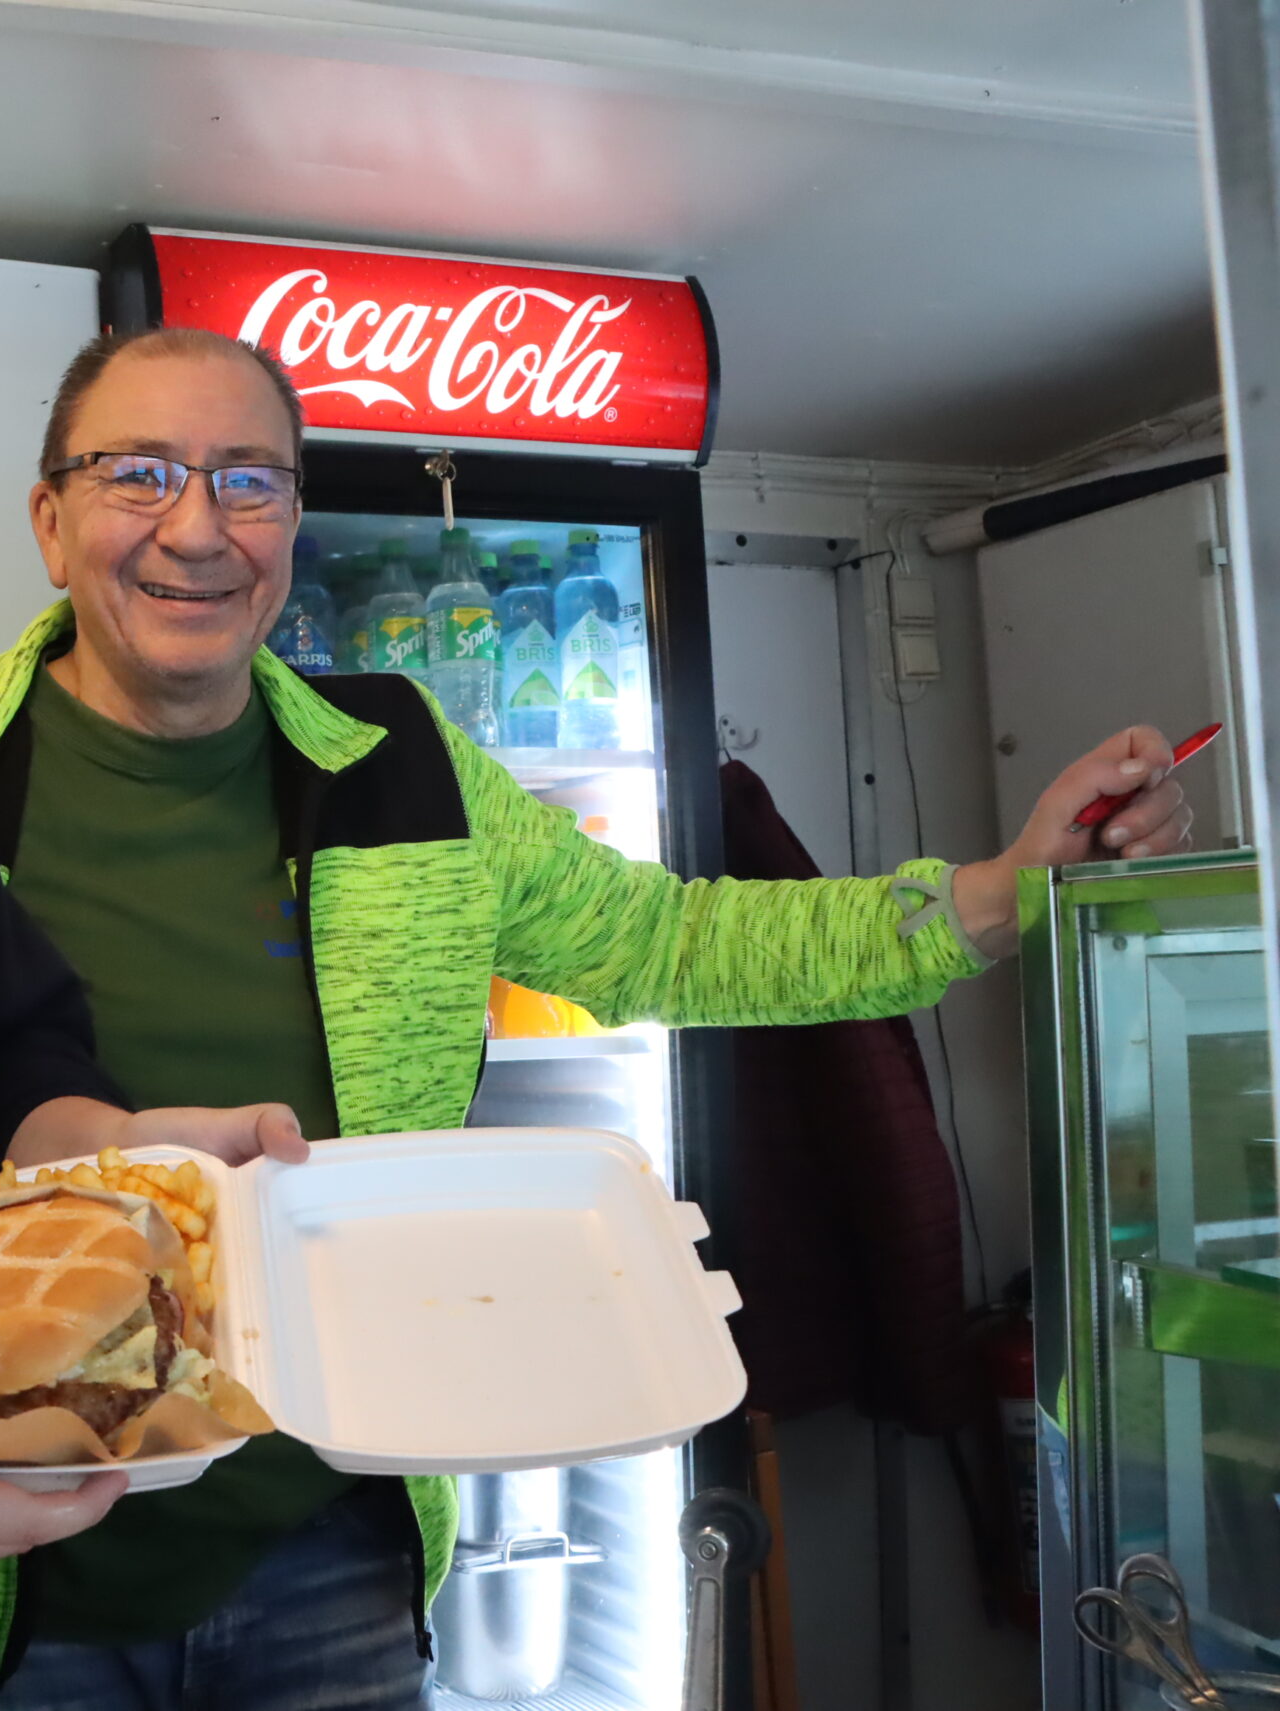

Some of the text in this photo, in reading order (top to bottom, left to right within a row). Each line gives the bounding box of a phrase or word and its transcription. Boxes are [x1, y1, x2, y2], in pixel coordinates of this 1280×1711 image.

[235, 268, 632, 419] Coca-Cola
[456, 616, 494, 658] Sprit
[571, 639, 612, 653] BRIS
[282, 653, 333, 667] ARRIS
[516, 647, 556, 661] BRIS
